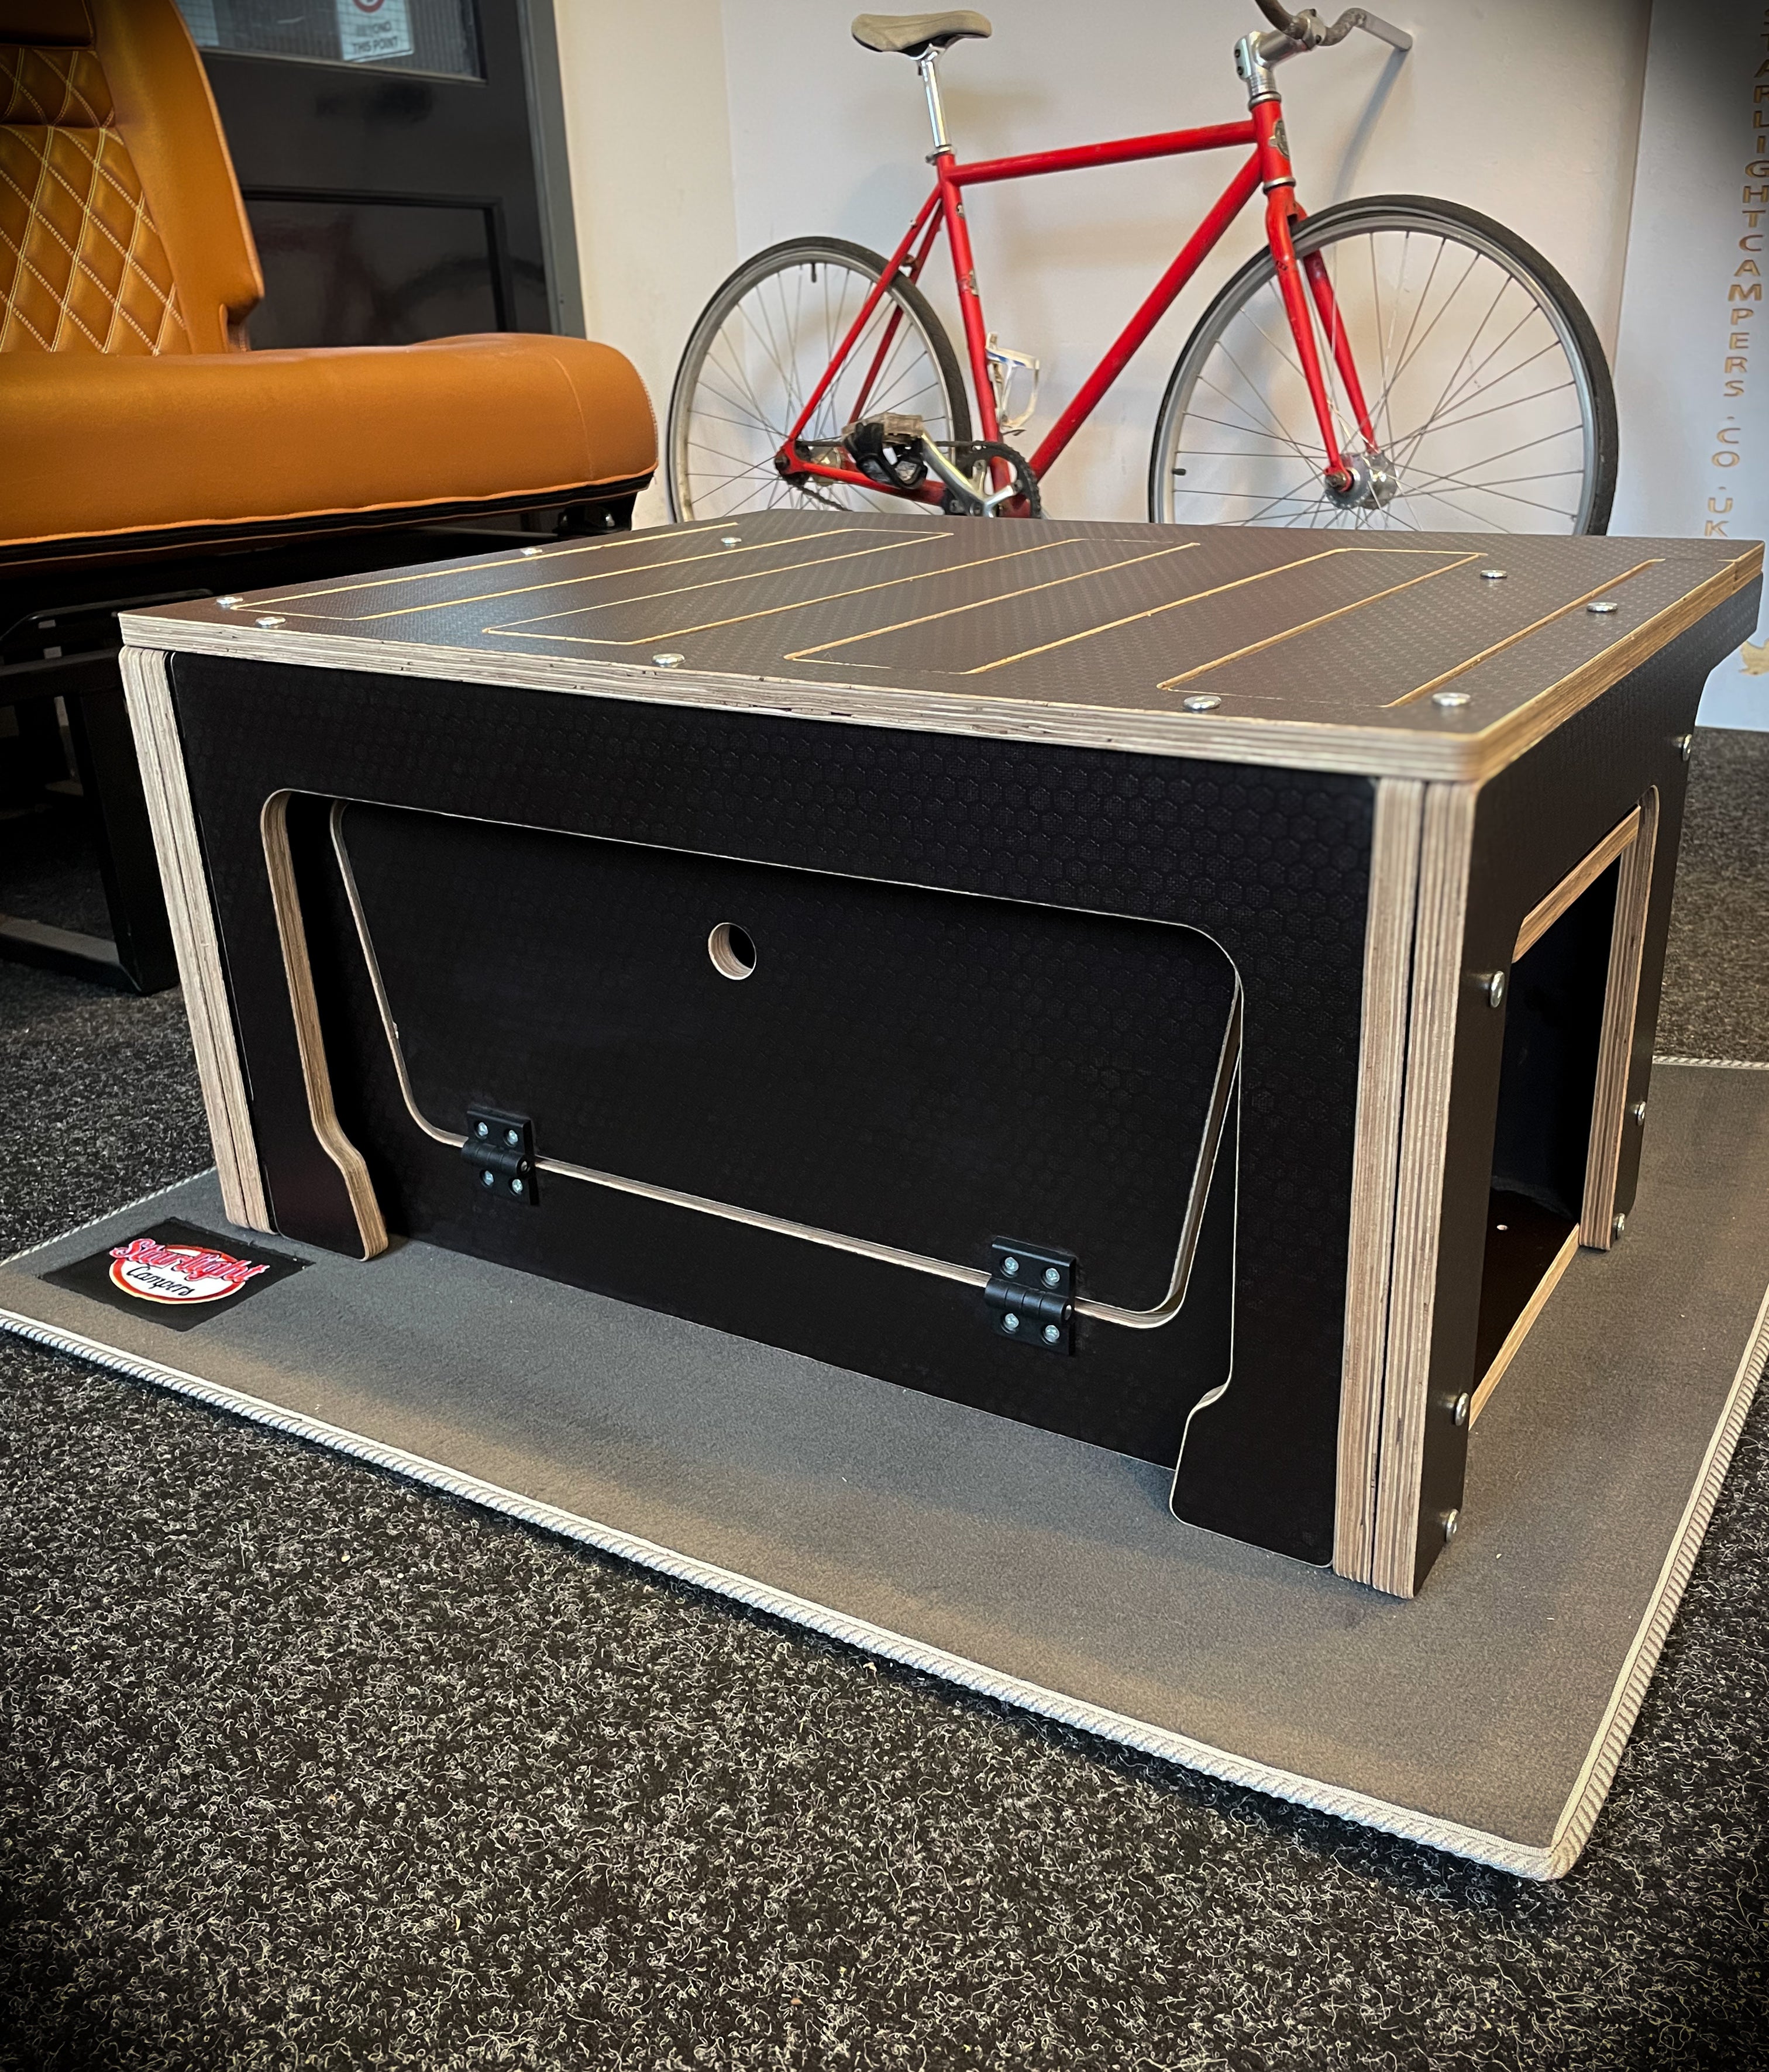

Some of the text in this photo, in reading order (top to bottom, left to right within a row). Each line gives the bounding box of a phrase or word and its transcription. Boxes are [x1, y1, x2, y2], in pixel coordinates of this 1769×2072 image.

[352, 36, 398, 54] THIS POINT
[109, 1238, 270, 1282] Starlight
[126, 1266, 195, 1296] Campers
